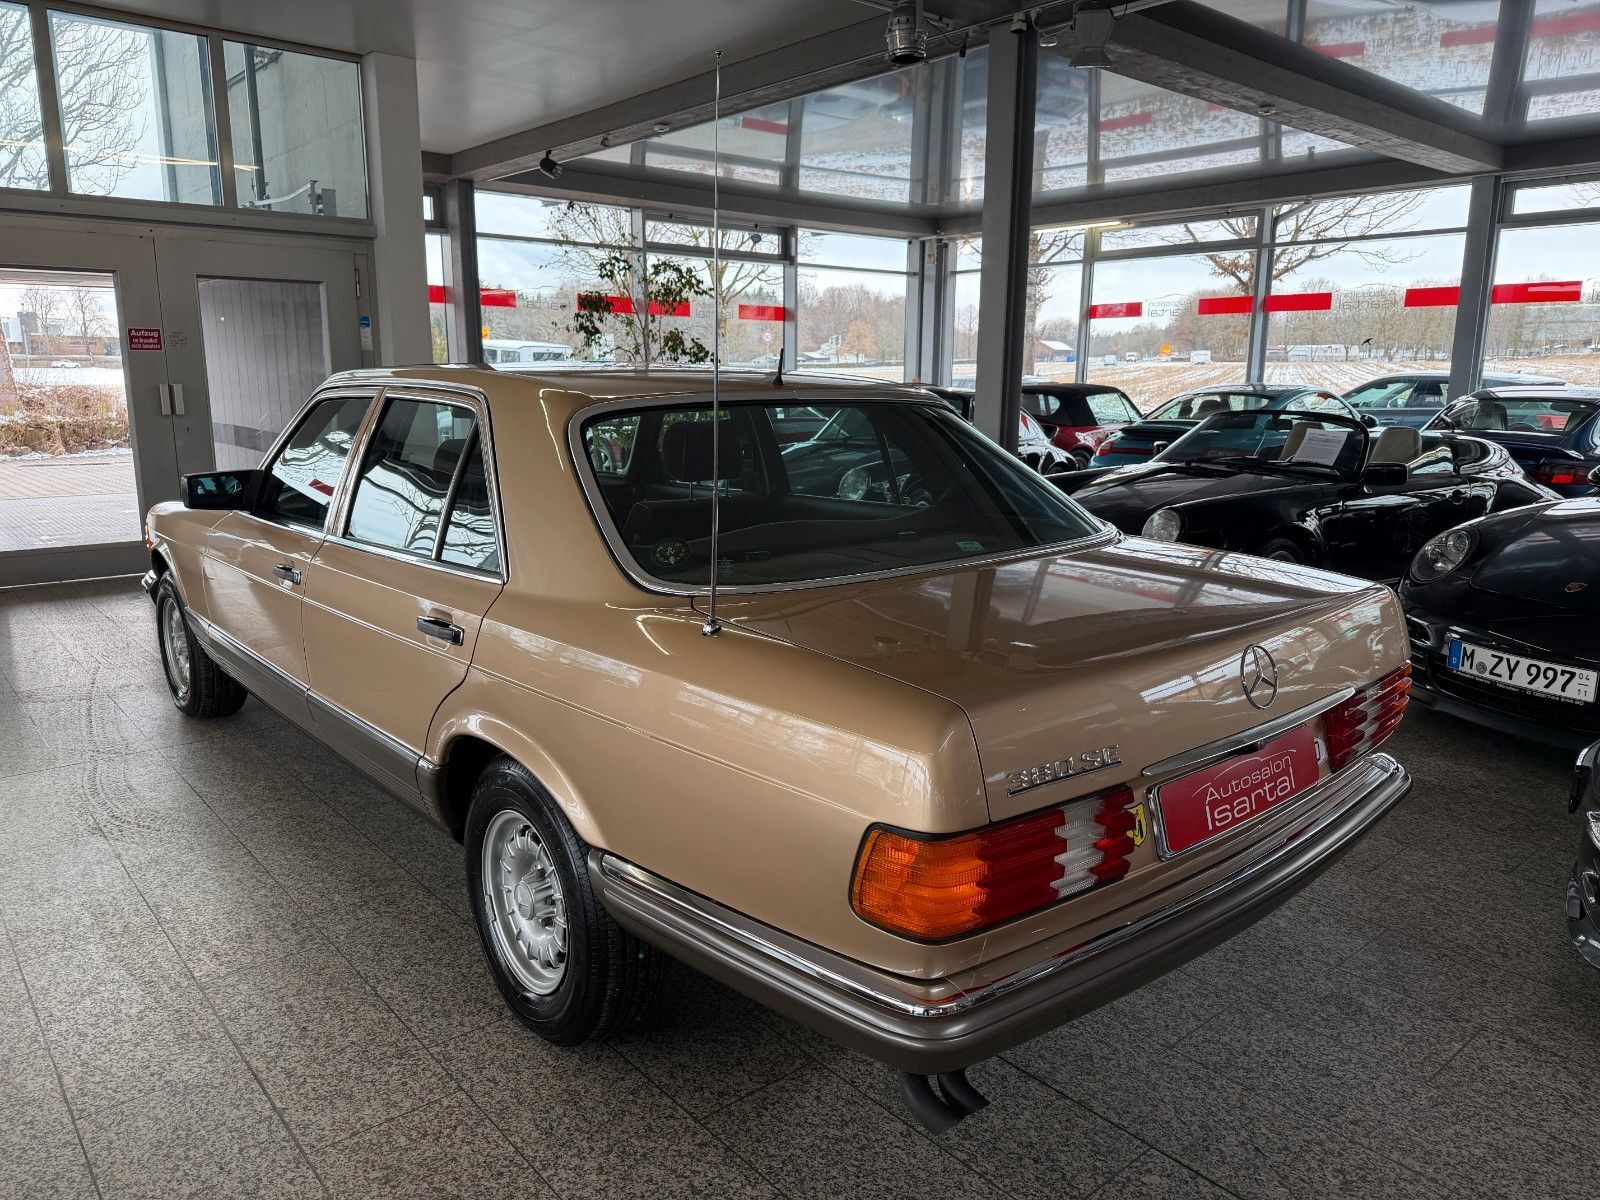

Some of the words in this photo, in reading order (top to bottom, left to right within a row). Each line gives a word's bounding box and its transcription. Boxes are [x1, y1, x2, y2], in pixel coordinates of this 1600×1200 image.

[130, 330, 158, 338] Aufzug
[1461, 646, 1476, 670] M
[1488, 653, 1521, 681] ZY
[1526, 663, 1577, 693] 997
[1578, 672, 1590, 681] 04
[1577, 689, 1588, 697] 11
[1081, 744, 1121, 769] SE
[1205, 754, 1293, 805] Autosalon
[1205, 766, 1297, 831] Isartal
